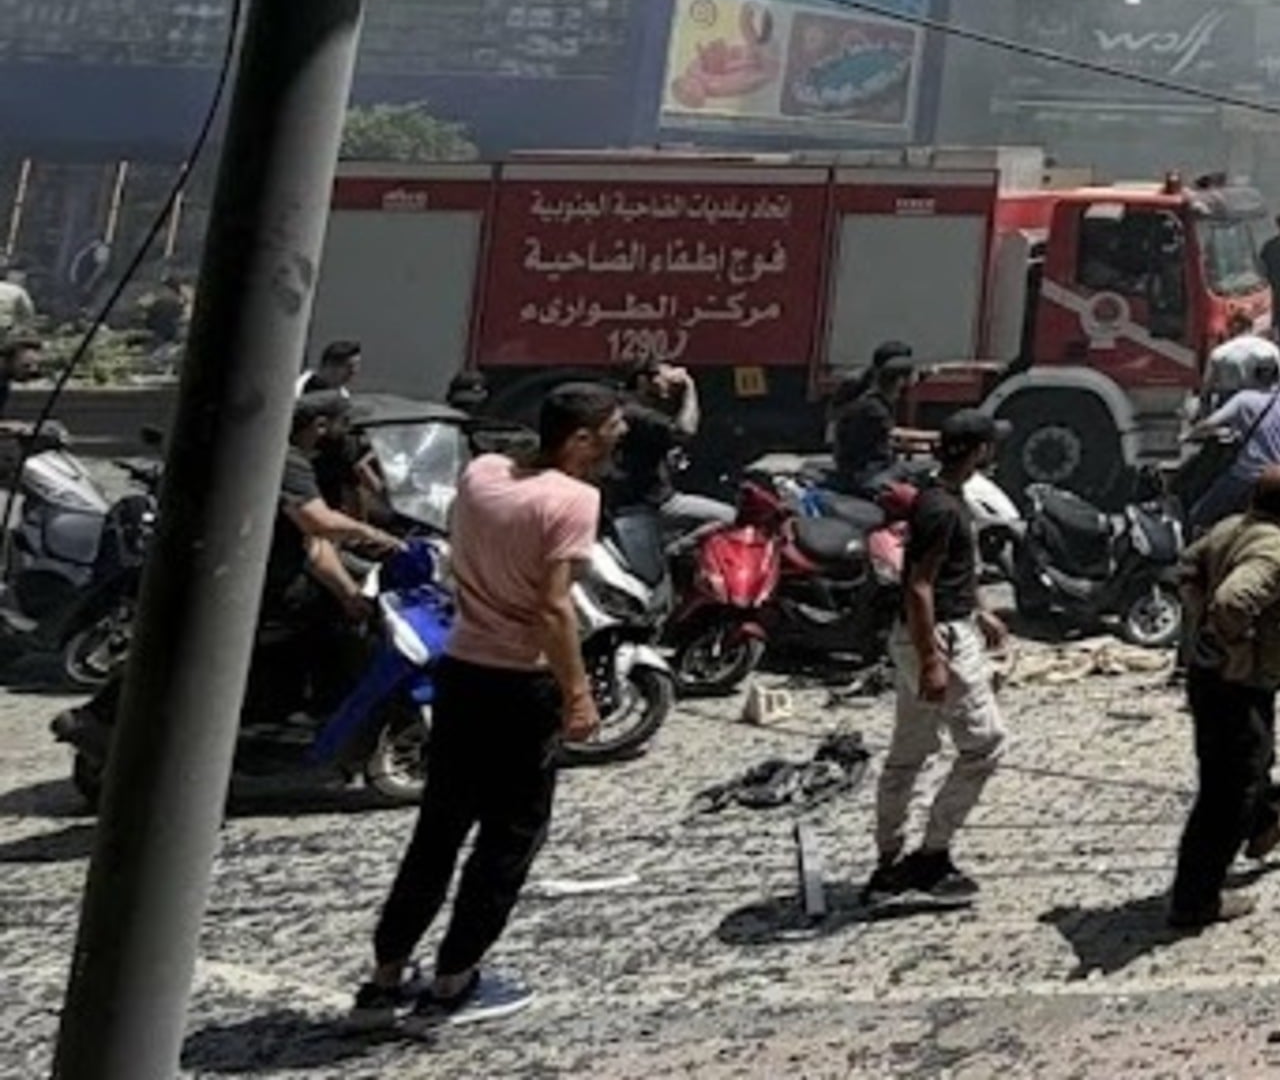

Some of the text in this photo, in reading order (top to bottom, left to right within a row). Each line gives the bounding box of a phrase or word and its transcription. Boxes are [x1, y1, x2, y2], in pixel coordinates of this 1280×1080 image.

[531, 189, 605, 223] الجنوبية
[612, 191, 684, 221] الضاحية
[524, 236, 646, 280] الضاحية
[728, 238, 786, 283] فوج
[679, 293, 781, 327] مركز
